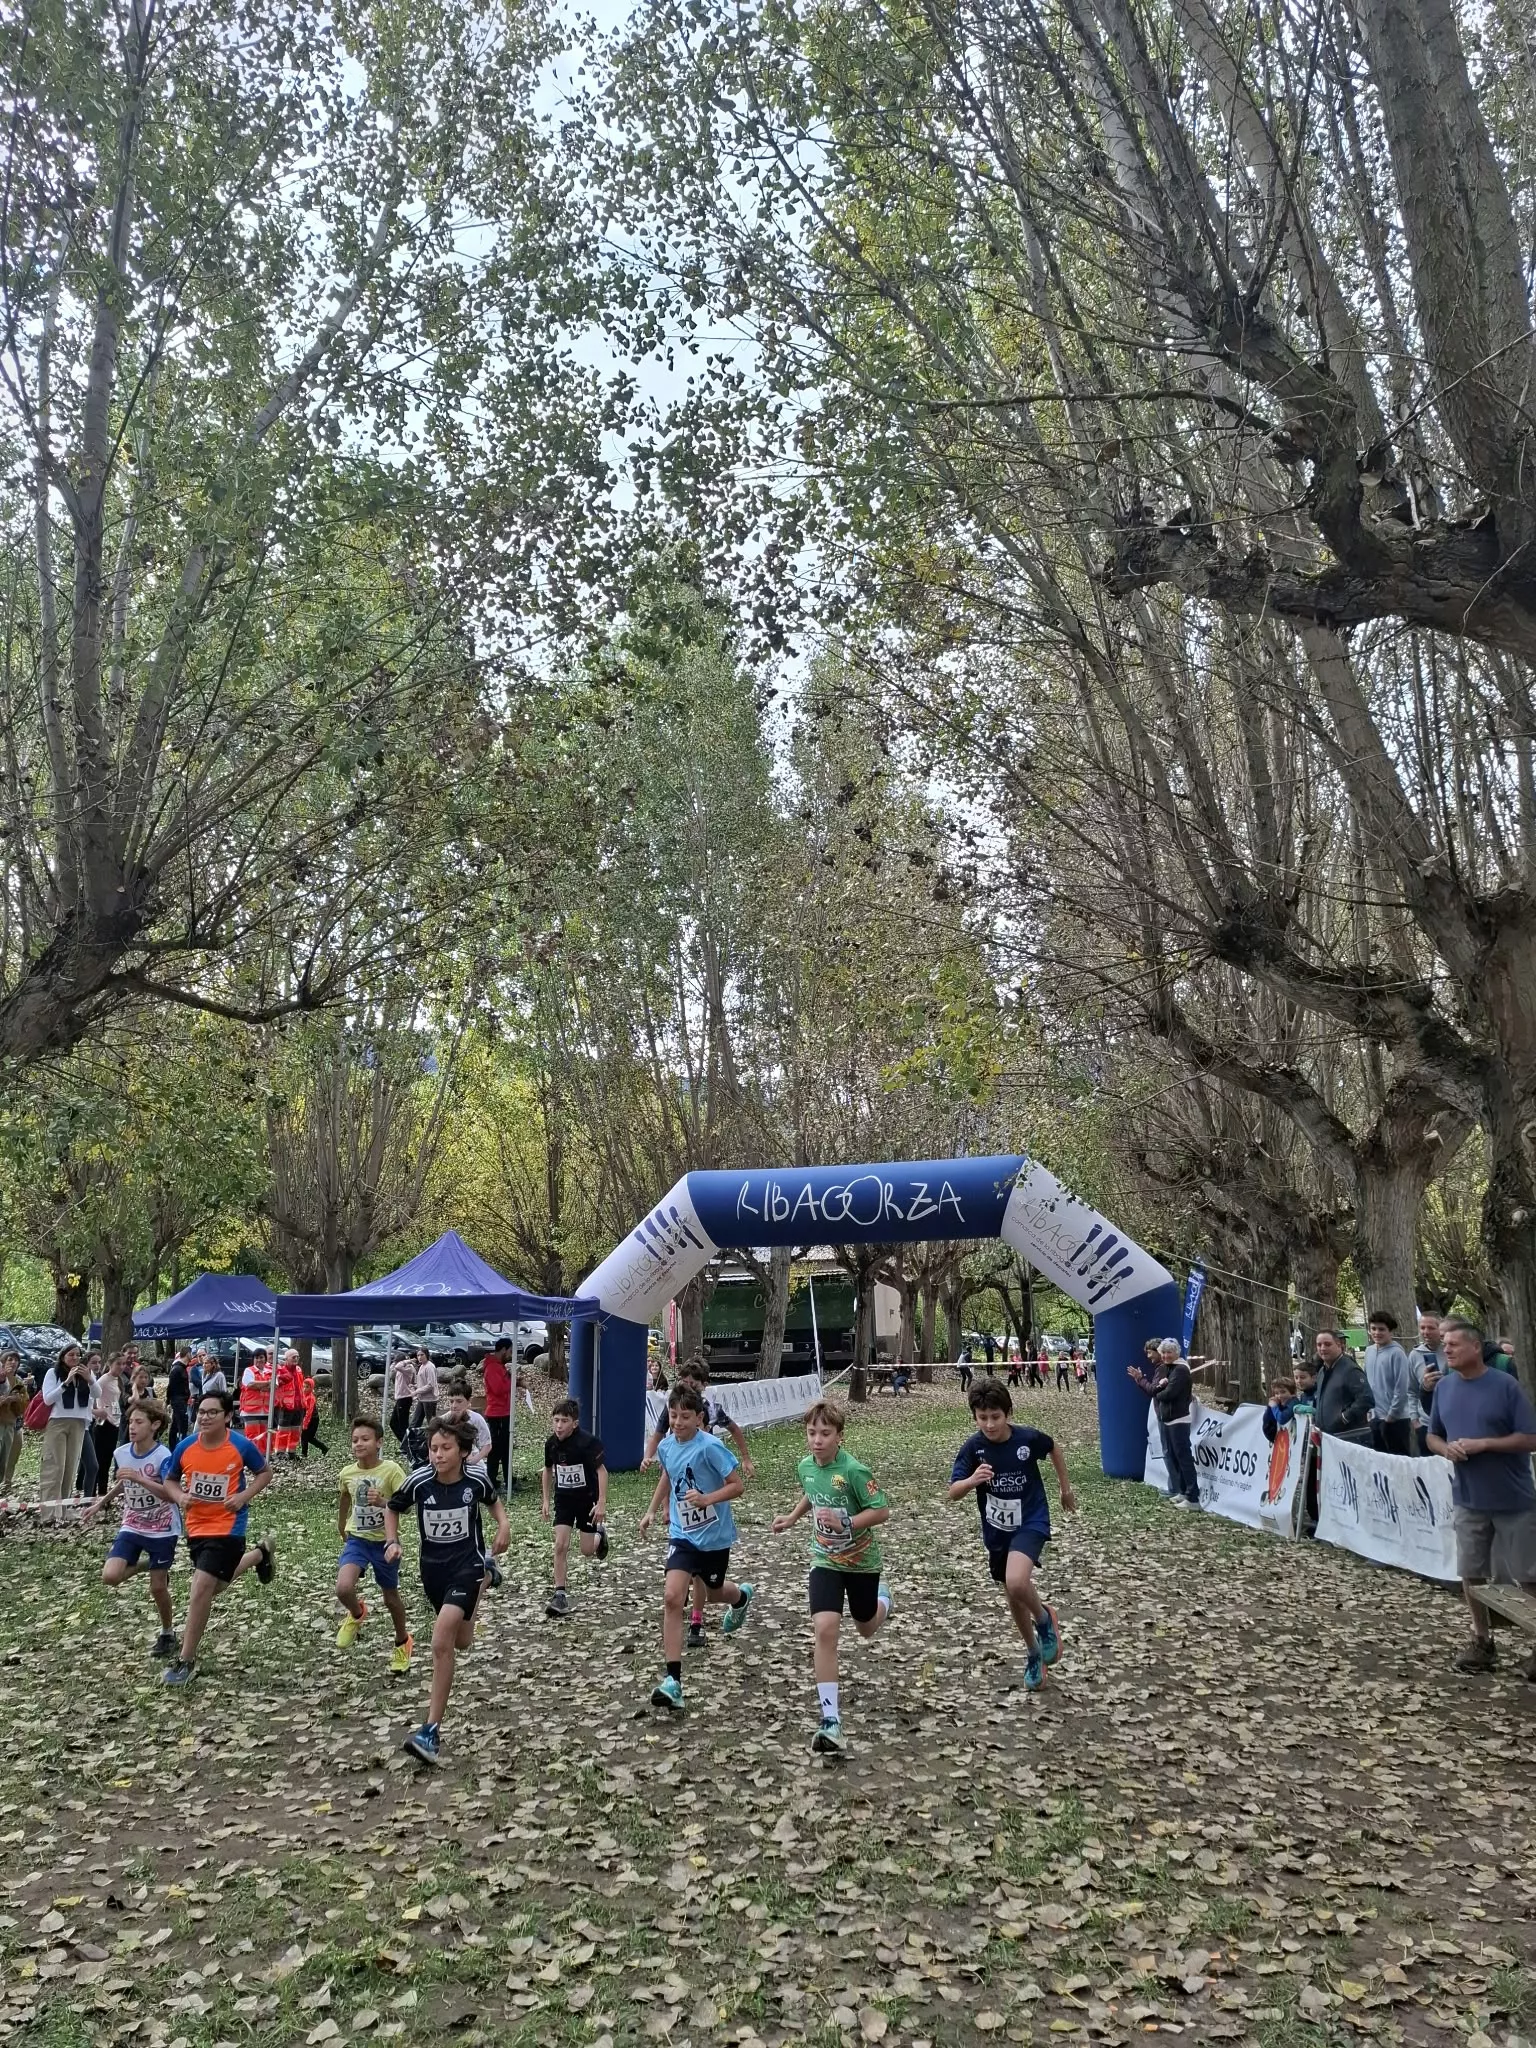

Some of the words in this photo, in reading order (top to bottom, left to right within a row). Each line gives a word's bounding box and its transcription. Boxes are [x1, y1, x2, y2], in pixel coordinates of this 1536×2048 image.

[736, 1175, 966, 1226] RIBAGORZA
[1232, 1449, 1257, 1477] SOS
[559, 1472, 581, 1485] 748
[194, 1482, 223, 1497] 698
[129, 1494, 156, 1508] 719
[808, 1492, 849, 1506] uesca
[357, 1511, 385, 1527] 733
[682, 1507, 709, 1527] 747
[990, 1506, 1015, 1525] 741
[429, 1520, 463, 1537] 723
